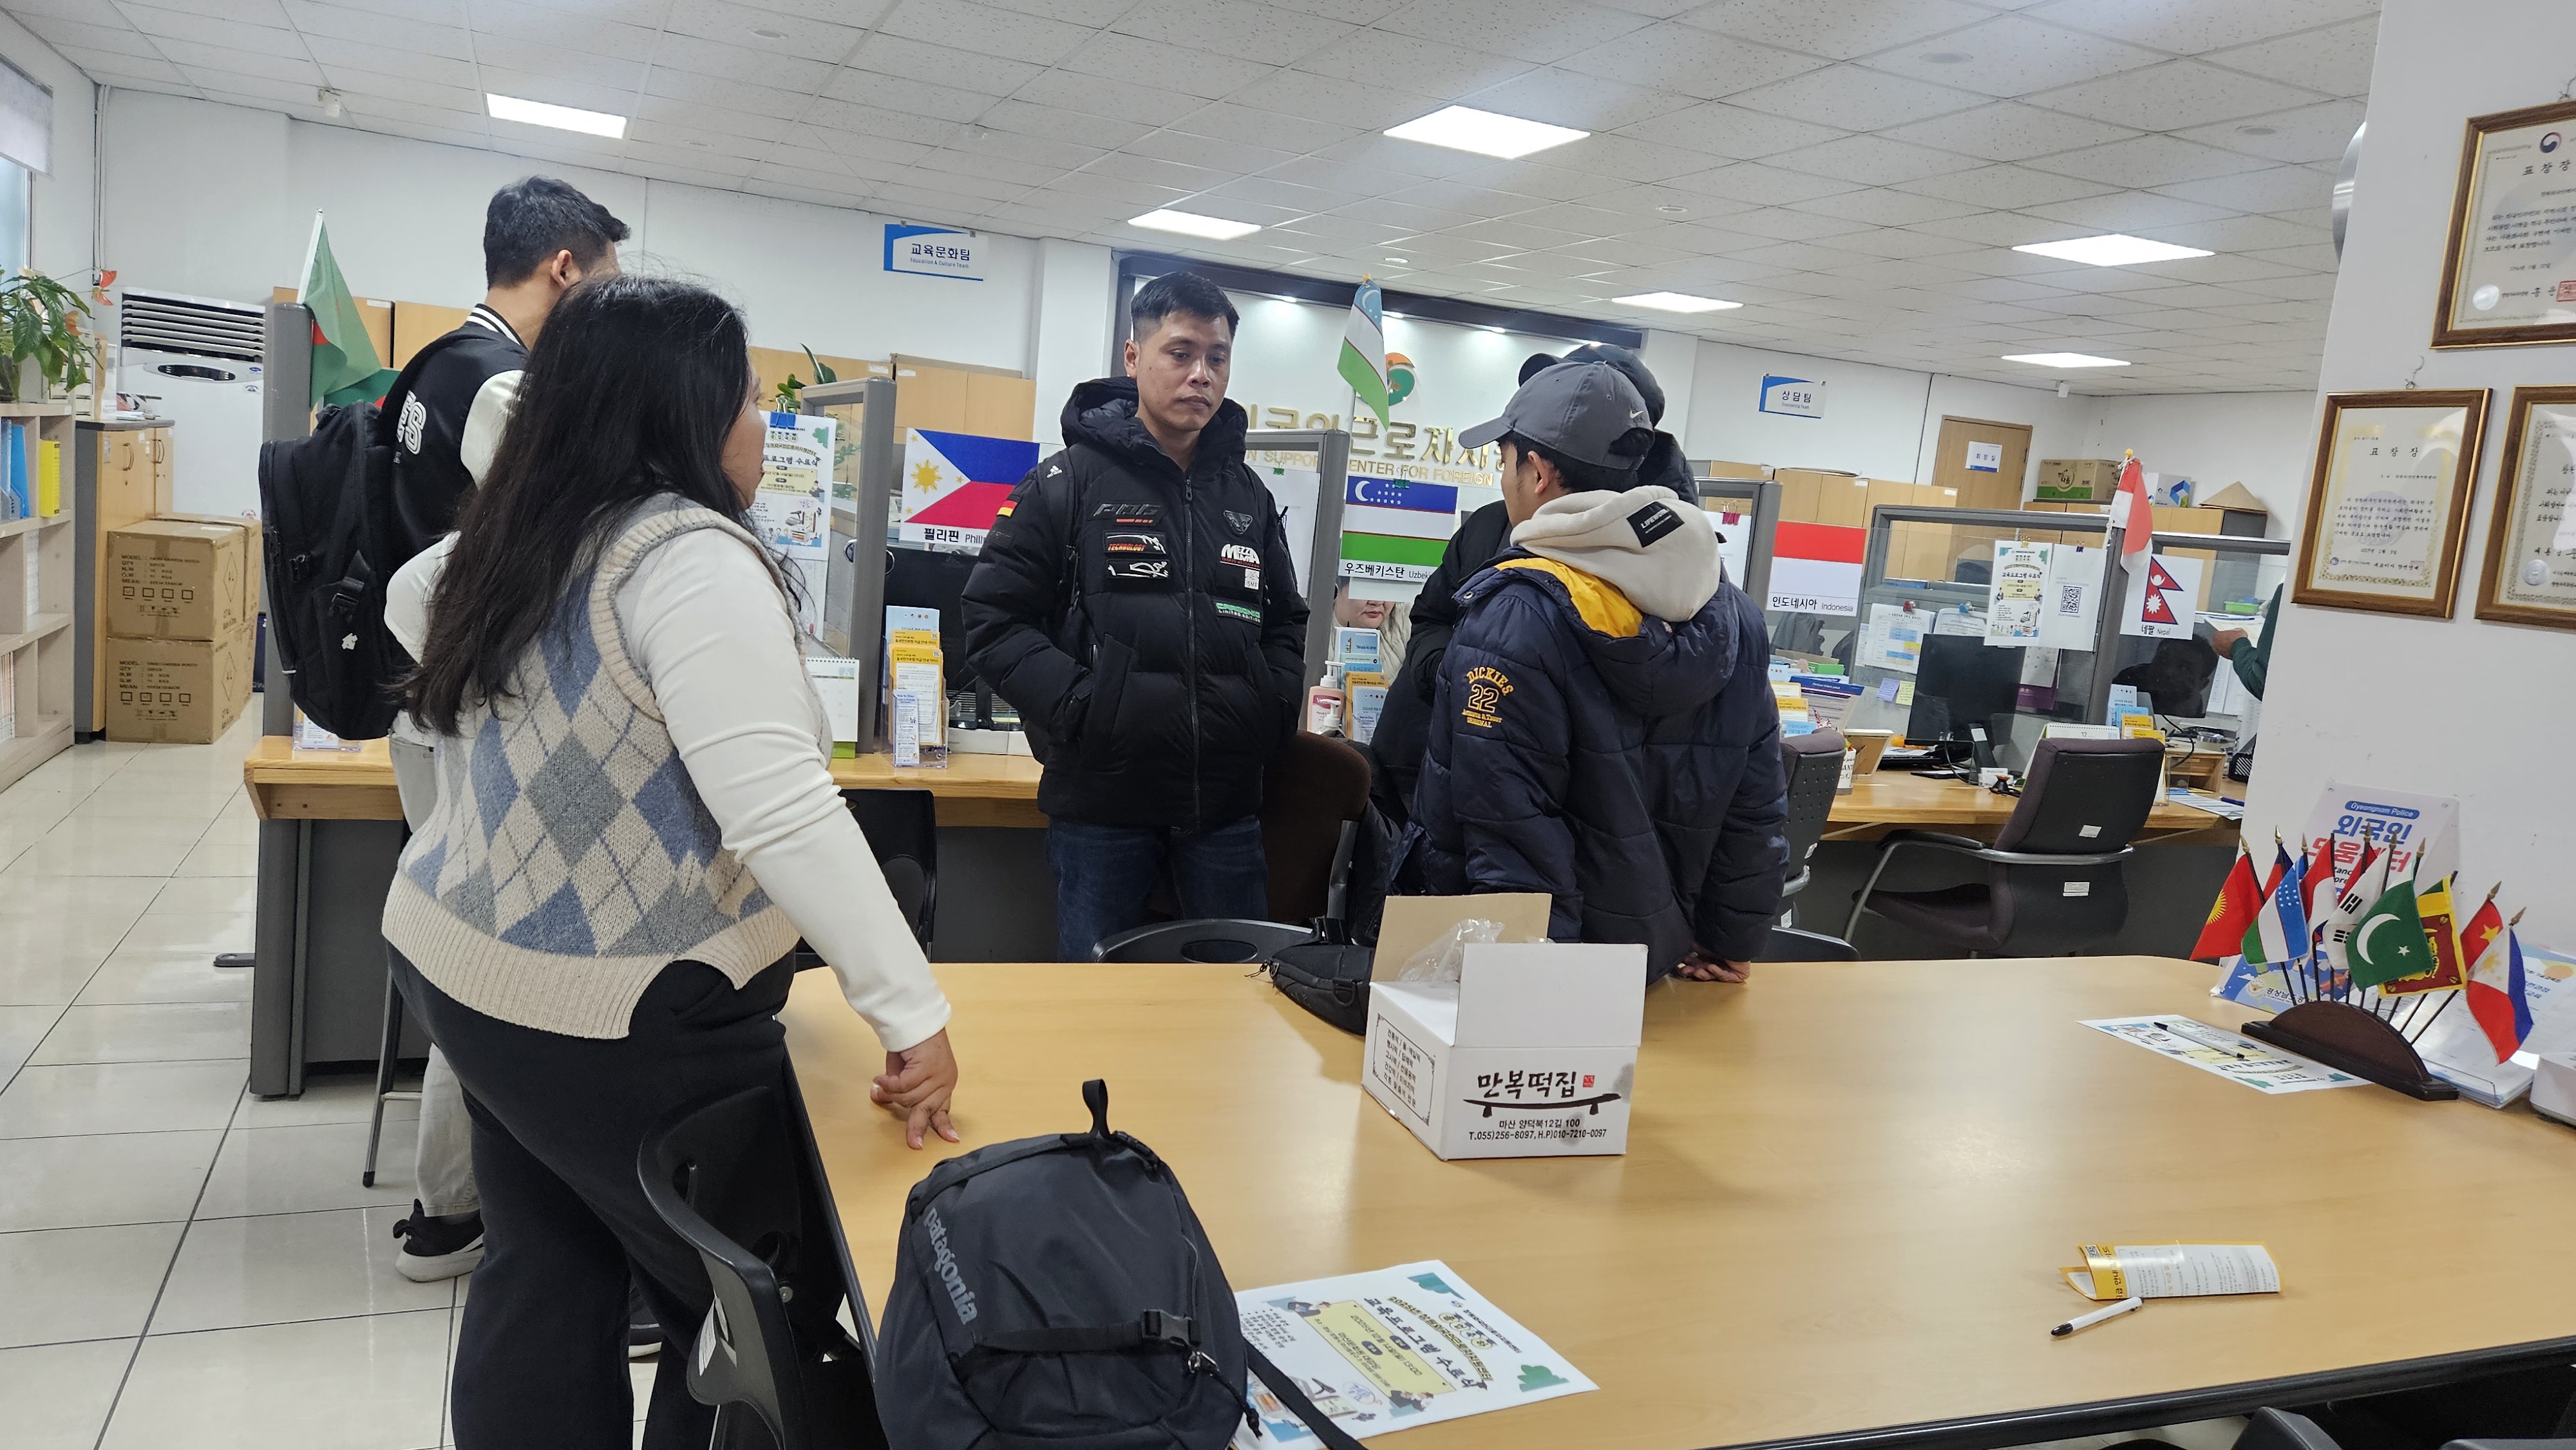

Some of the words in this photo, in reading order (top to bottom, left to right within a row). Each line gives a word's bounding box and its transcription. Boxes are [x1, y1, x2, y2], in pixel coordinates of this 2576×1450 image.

[911, 243, 970, 261] 교육문화팀
[1782, 390, 1812, 403] 상담팀
[1349, 459, 1394, 475] ENTER
[1399, 464, 1428, 480] FOR
[1434, 468, 1493, 486] FOREIGN
[924, 528, 959, 542] 필리핀
[965, 534, 985, 544] Phili
[1344, 562, 1405, 579] 우즈베키스탄
[1772, 596, 1818, 610] 인도네시아
[1821, 601, 1853, 612] Indonesia
[2141, 624, 2155, 636] 네팔
[2157, 627, 2171, 636] Nepal
[1466, 666, 1514, 696] DICKIES
[1468, 683, 1499, 713] 22
[2351, 802, 2391, 814] Gyeongnam
[2391, 808, 2414, 818] Police
[2332, 814, 2413, 845] 외국인
[1477, 1069, 1577, 1099] 만복떡집
[1499, 1119, 1516, 1129] 마산
[1519, 1118, 1562, 1129] 양덕북12길
[1565, 1118, 1580, 1128] 100
[923, 1207, 978, 1325] patagonia
[2112, 1269, 2121, 1285] 안내
[1363, 1296, 1443, 1355] 교육프로그램
[1432, 1355, 1481, 1389] 수료식
[1386, 1295, 1423, 1314] 2025년
[1416, 1313, 1495, 1380] 창원외국인근로자지원센터
